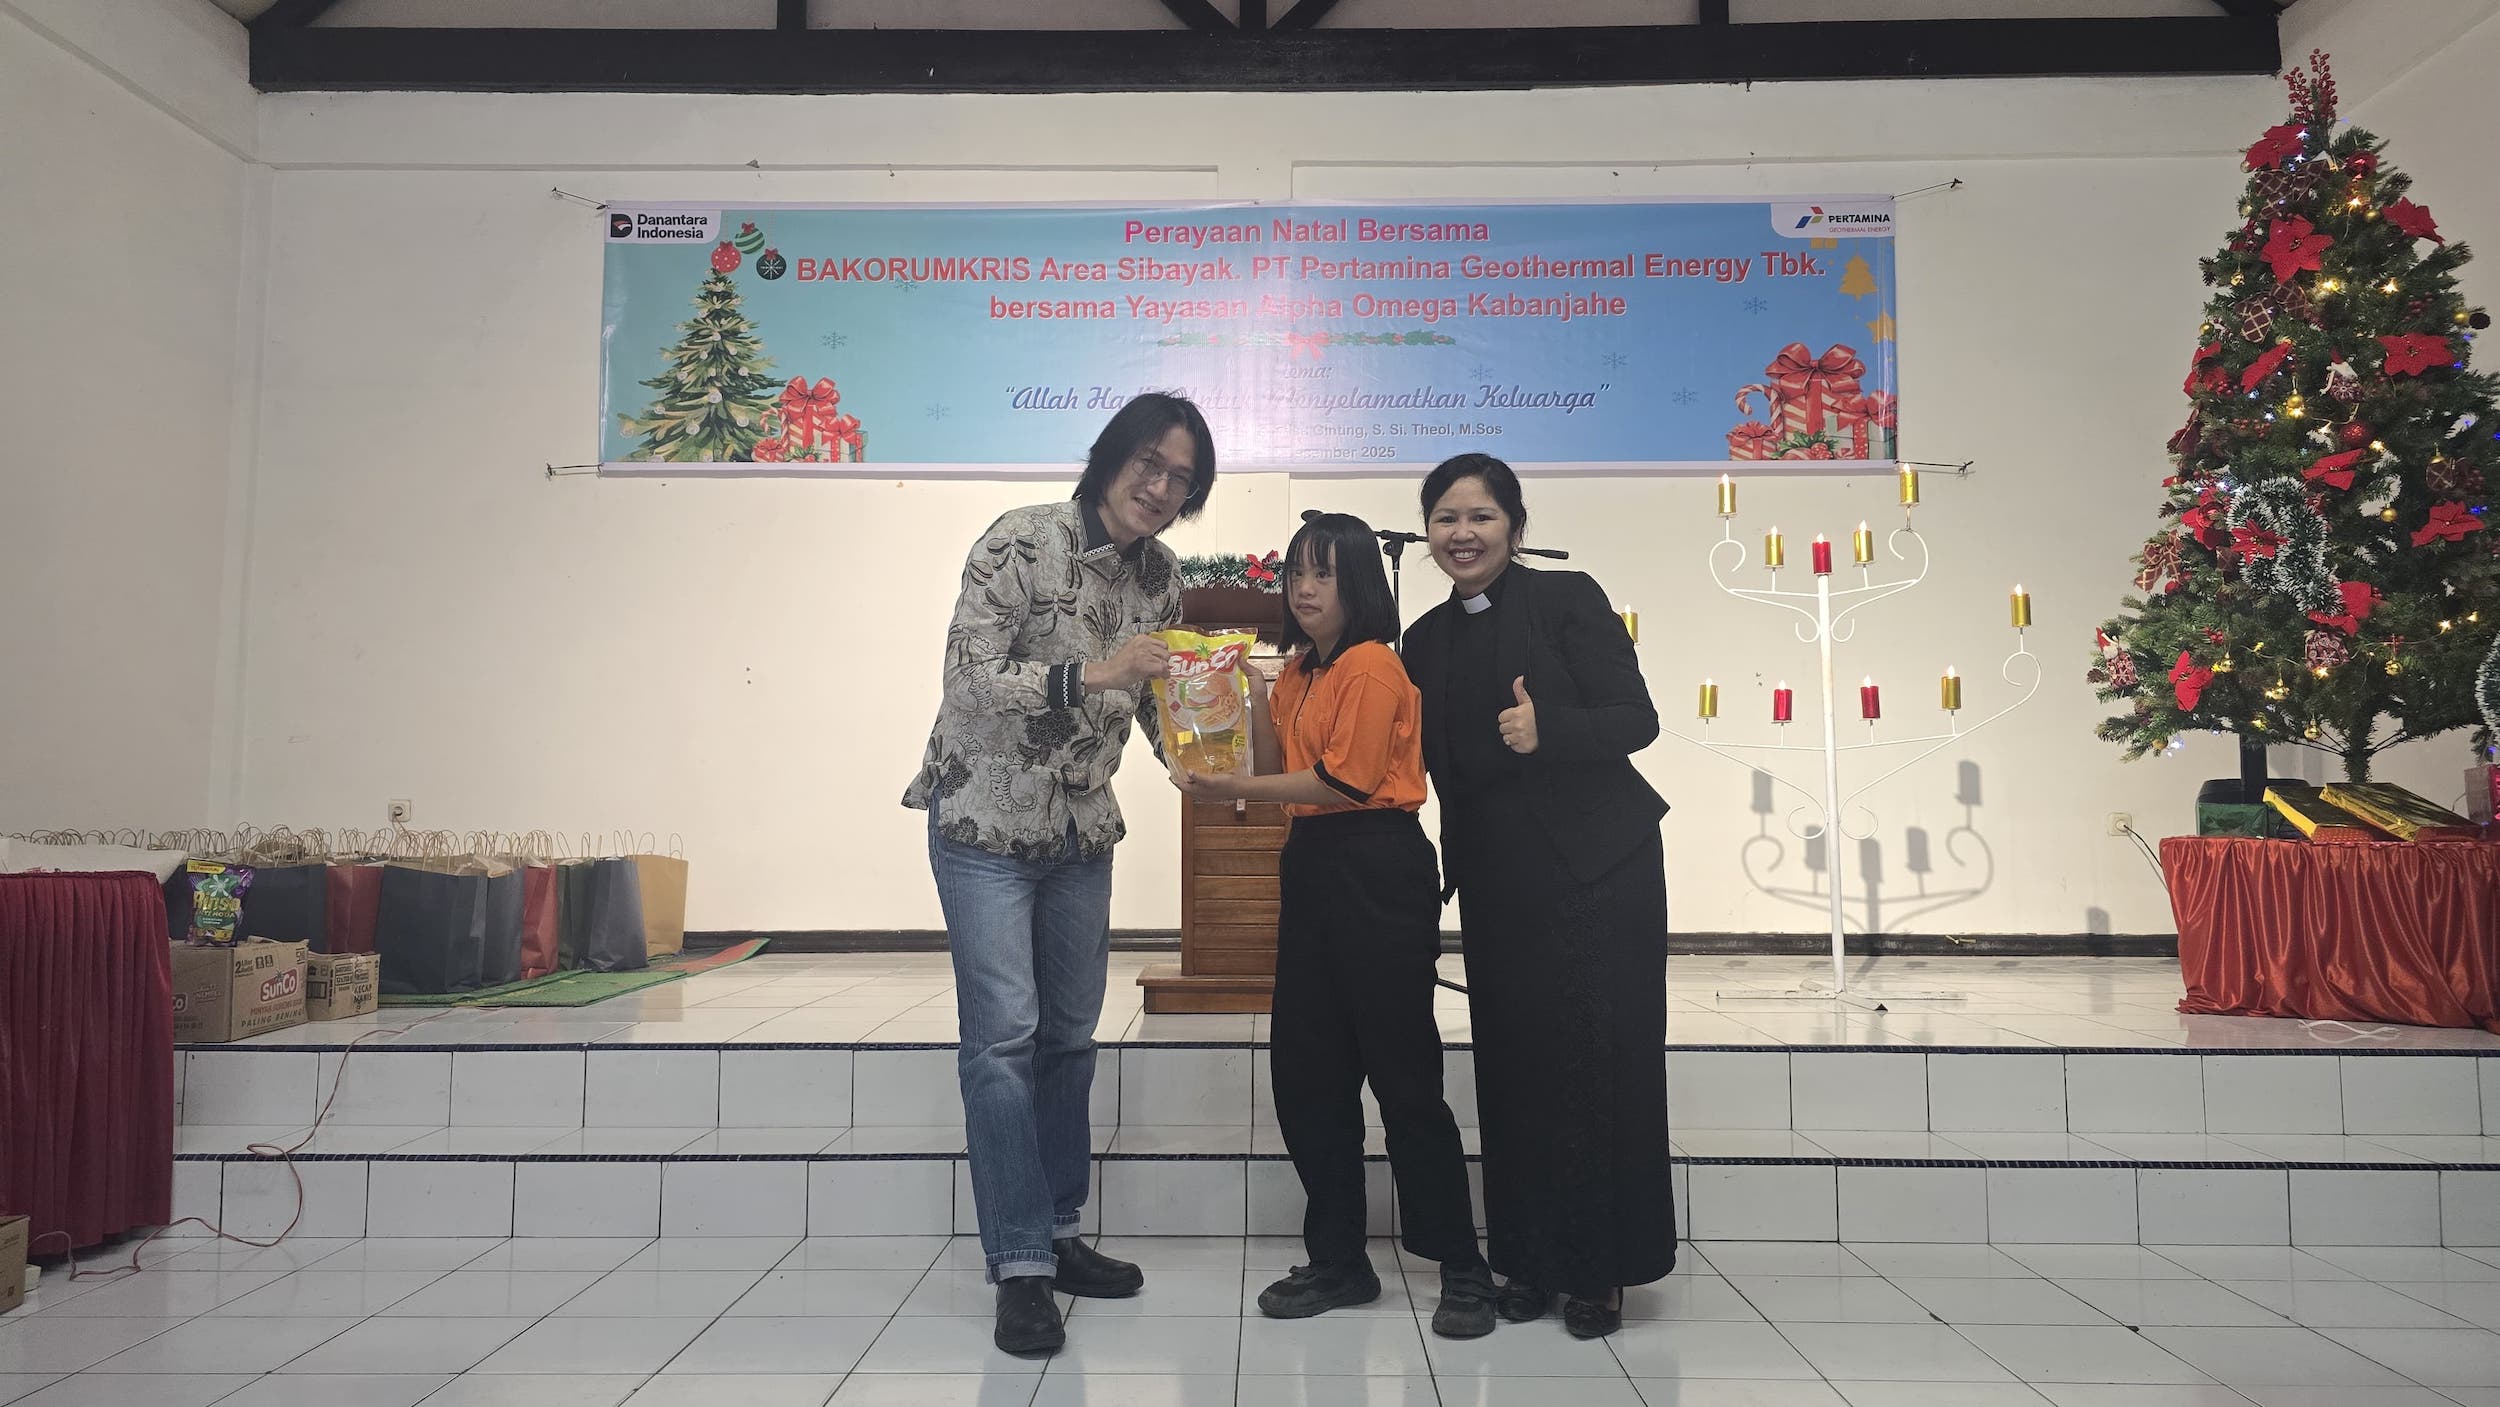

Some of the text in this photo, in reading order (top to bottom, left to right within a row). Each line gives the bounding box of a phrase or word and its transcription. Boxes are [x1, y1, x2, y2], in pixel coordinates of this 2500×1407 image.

[637, 213, 708, 226] Danantara
[1828, 214, 1891, 223] PERTAMINA
[637, 227, 704, 239] Indonesia
[1124, 218, 1490, 250] Perayaan Natal Bersama
[797, 251, 1825, 287] BAKORUMKRIS Area Sibayak. PT Pertamina Geothermal Energy Tbk.
[990, 292, 1627, 325] bersama Yayasan Alpha Omega Kabanjahe
[1314, 424, 1368, 439] Ginting,
[1372, 424, 1386, 436] S.
[1390, 423, 1408, 436] Si.
[1413, 423, 1455, 438] Theol,
[1459, 423, 1504, 436] M.Sos
[1361, 446, 1397, 459] 2025
[234, 961, 241, 974] 2
[262, 973, 296, 1000] SunCo
